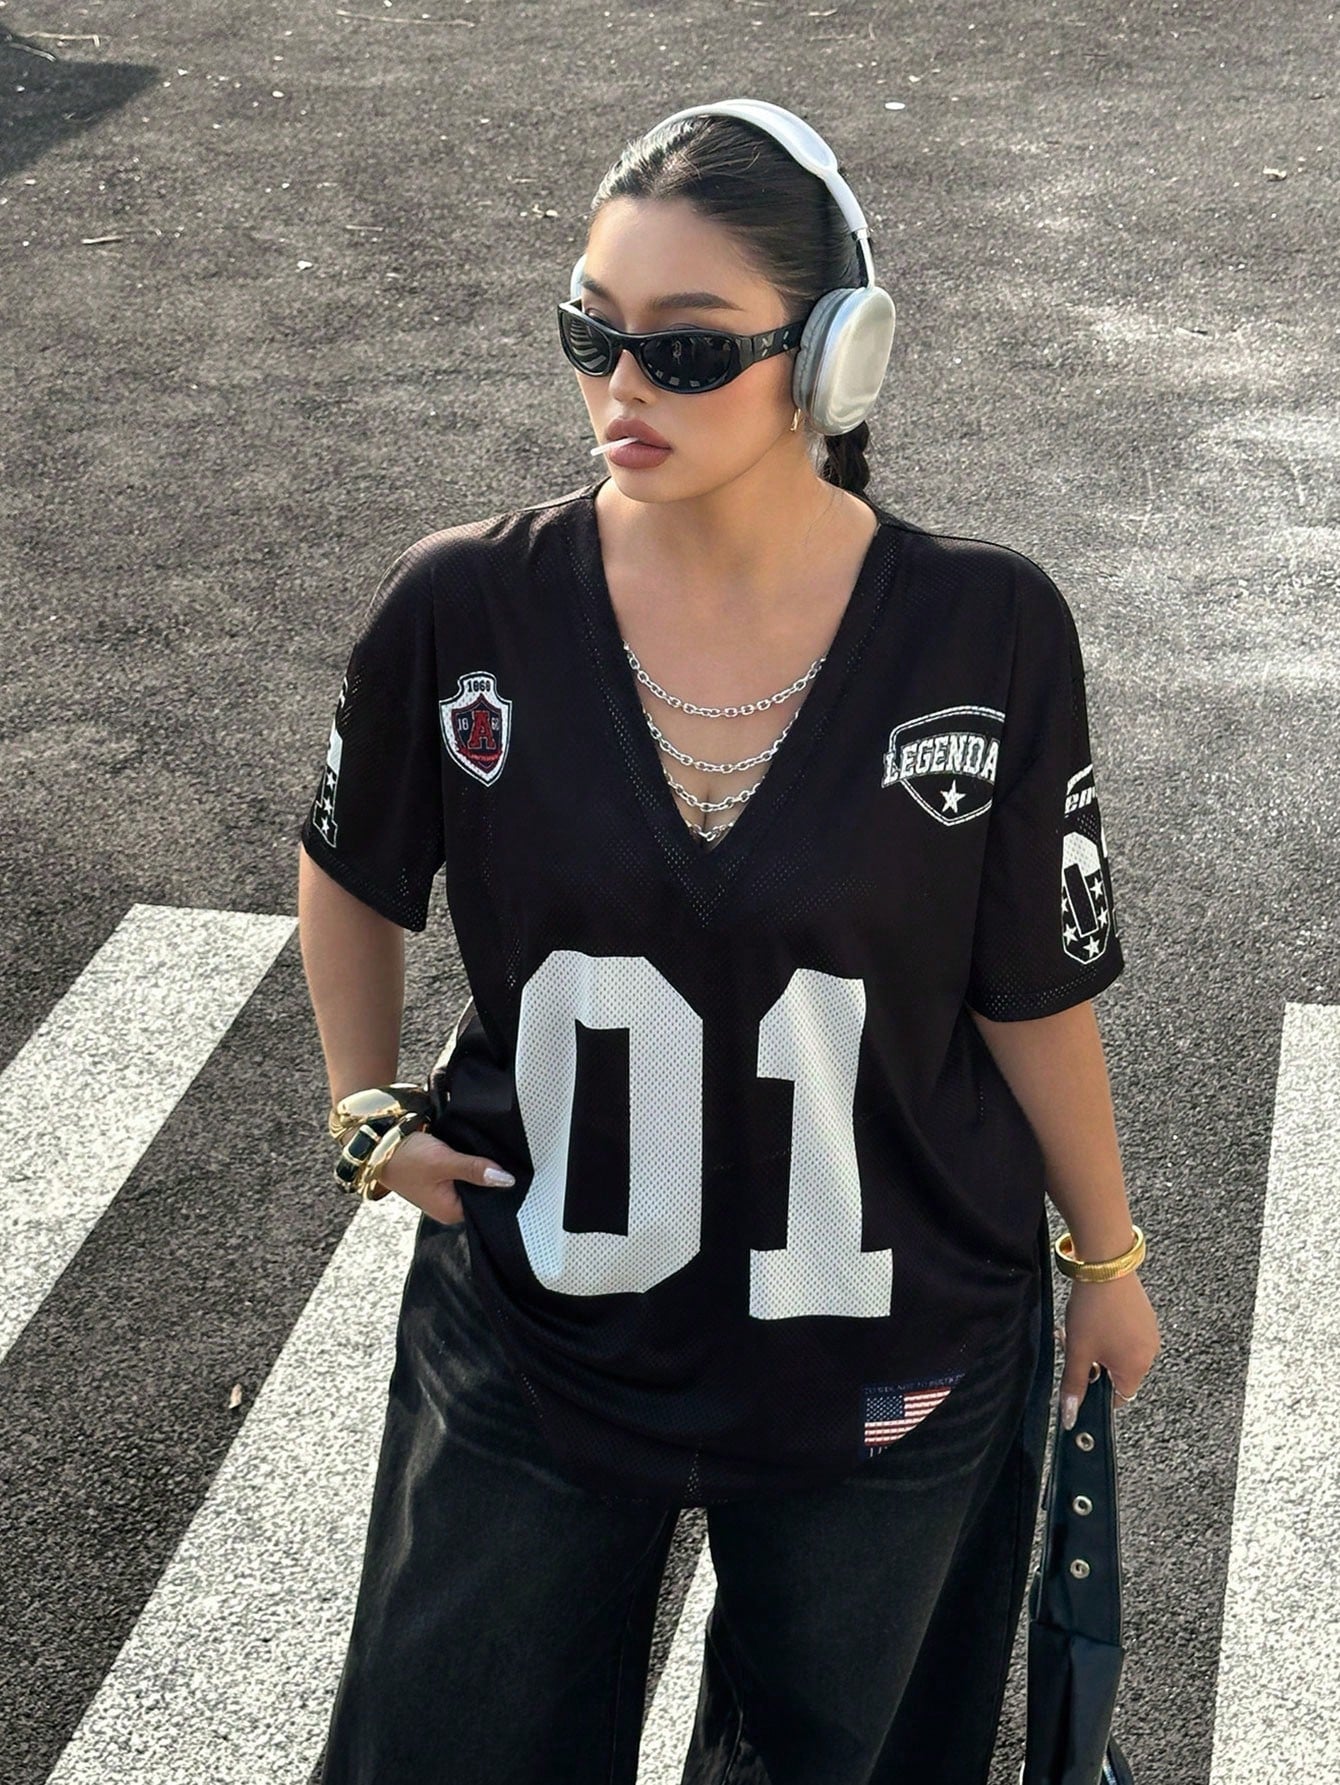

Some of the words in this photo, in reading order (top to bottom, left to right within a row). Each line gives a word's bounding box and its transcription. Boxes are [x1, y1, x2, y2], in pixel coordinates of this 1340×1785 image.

[467, 709, 497, 750] A
[881, 731, 1001, 788] LEGENDA
[515, 950, 893, 1320] 01
